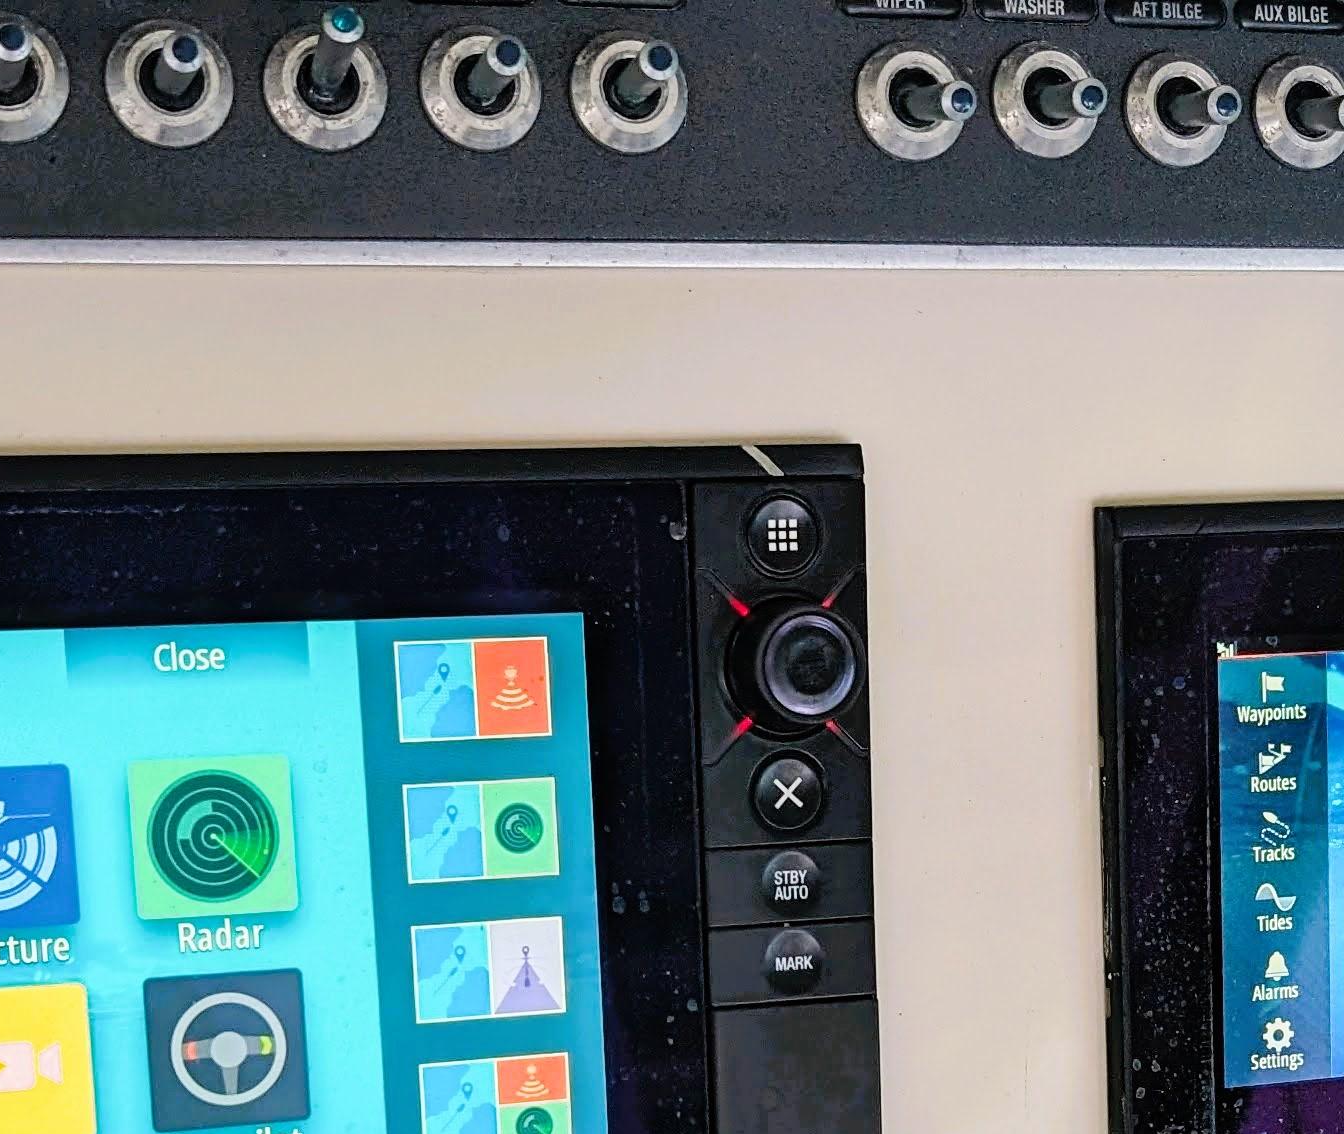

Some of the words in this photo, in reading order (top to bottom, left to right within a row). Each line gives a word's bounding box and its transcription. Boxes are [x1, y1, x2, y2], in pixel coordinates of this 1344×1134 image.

[1004, 0, 1065, 15] WASHER
[1132, 2, 1158, 17] AFT
[1162, 2, 1203, 19] BILGE
[1255, 5, 1283, 22] AUX
[1288, 6, 1329, 23] BILGE
[153, 642, 225, 672] Close
[1237, 704, 1307, 726] Waypoints
[1250, 775, 1297, 793] Routes
[1253, 844, 1295, 863] Tracks
[774, 870, 807, 885] STBY
[775, 885, 809, 900] AUTO
[1257, 913, 1293, 932] Tides
[178, 918, 264, 953] Radar
[776, 955, 813, 971] MARK
[1252, 983, 1299, 1002] Alarms
[1250, 1048, 1304, 1072] Settings
